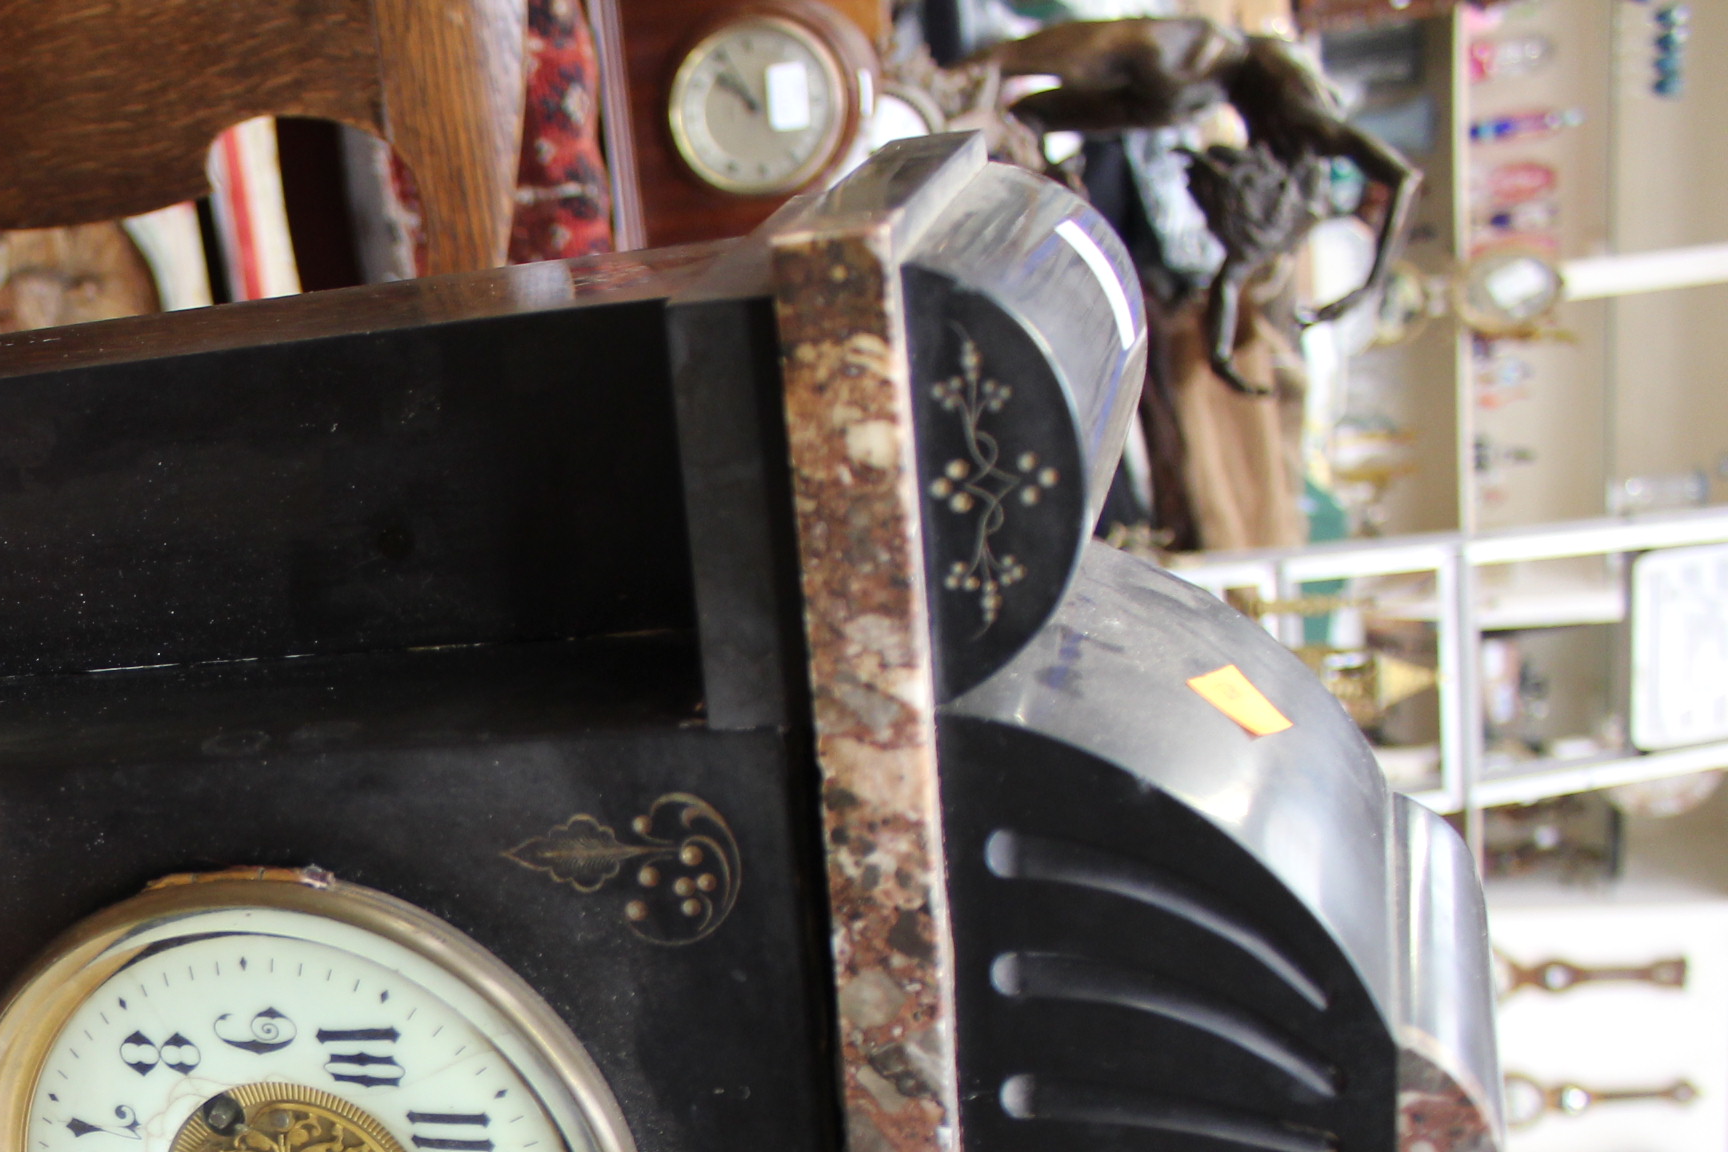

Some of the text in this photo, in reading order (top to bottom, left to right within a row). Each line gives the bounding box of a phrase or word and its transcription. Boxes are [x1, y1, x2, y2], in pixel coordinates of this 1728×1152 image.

[119, 1029, 202, 1077] 8
[213, 1006, 298, 1055] 9
[315, 1027, 406, 1087] 10
[66, 1104, 142, 1140] 7
